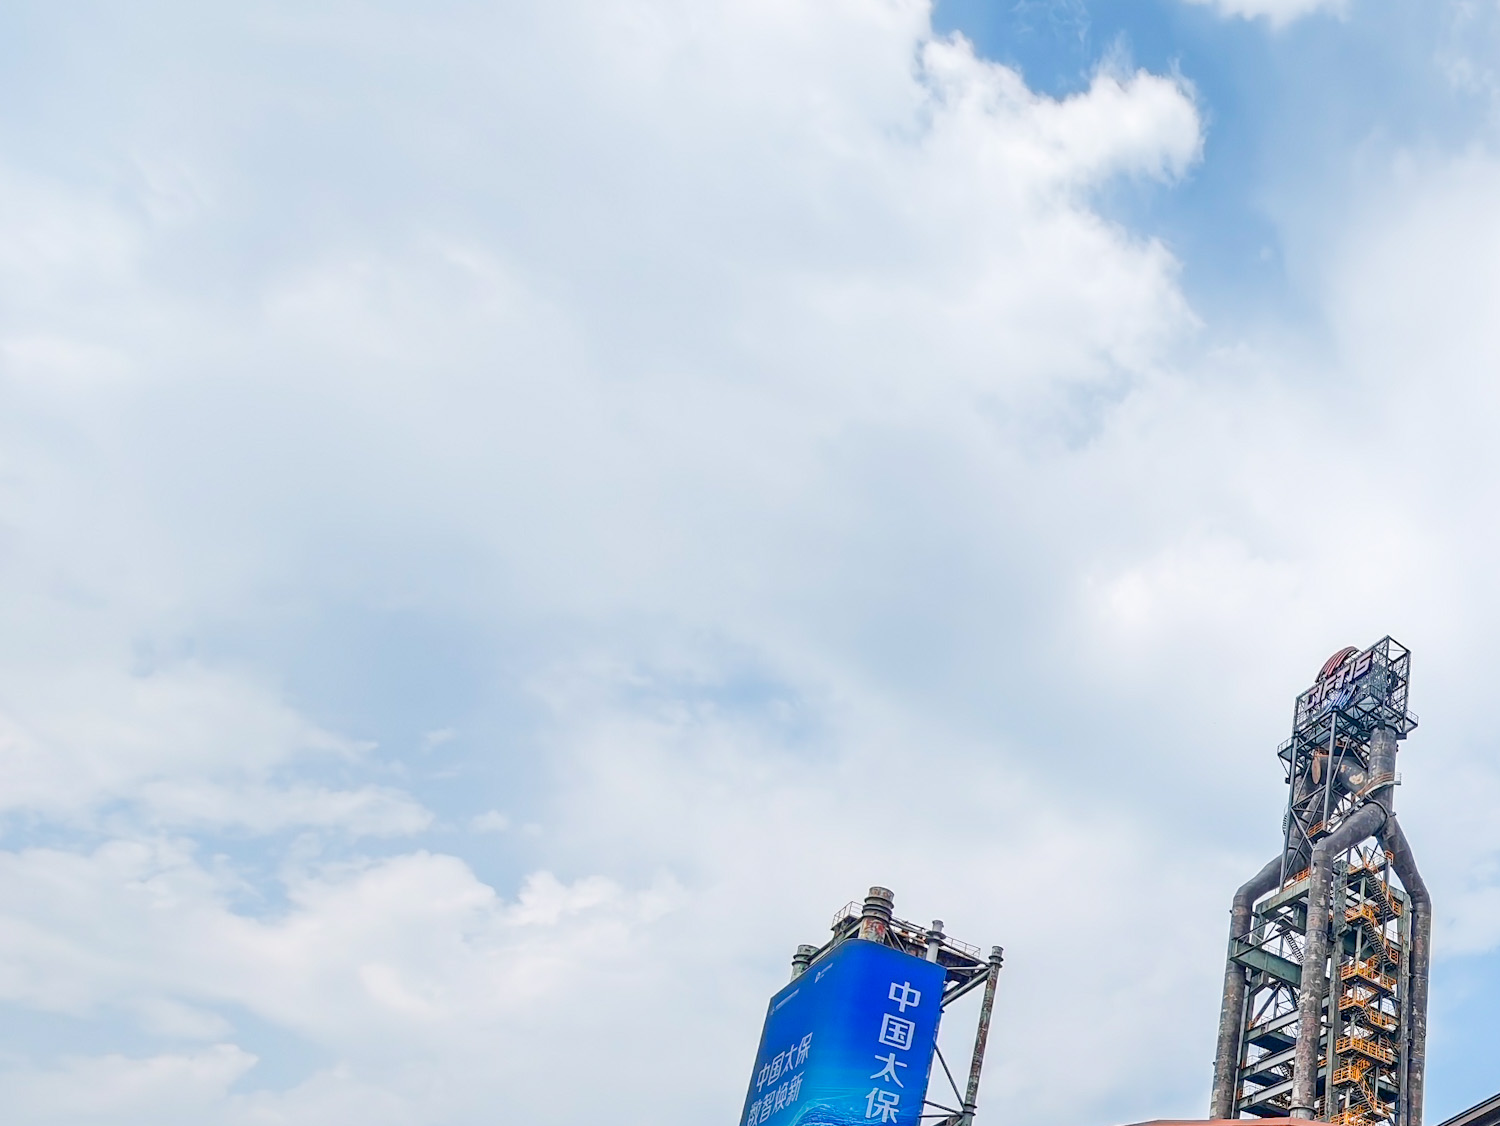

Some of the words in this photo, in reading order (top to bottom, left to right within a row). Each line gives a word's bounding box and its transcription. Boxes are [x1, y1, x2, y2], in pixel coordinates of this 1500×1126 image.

[757, 1032, 813, 1092] 中国太保
[865, 980, 922, 1123] 中国太保
